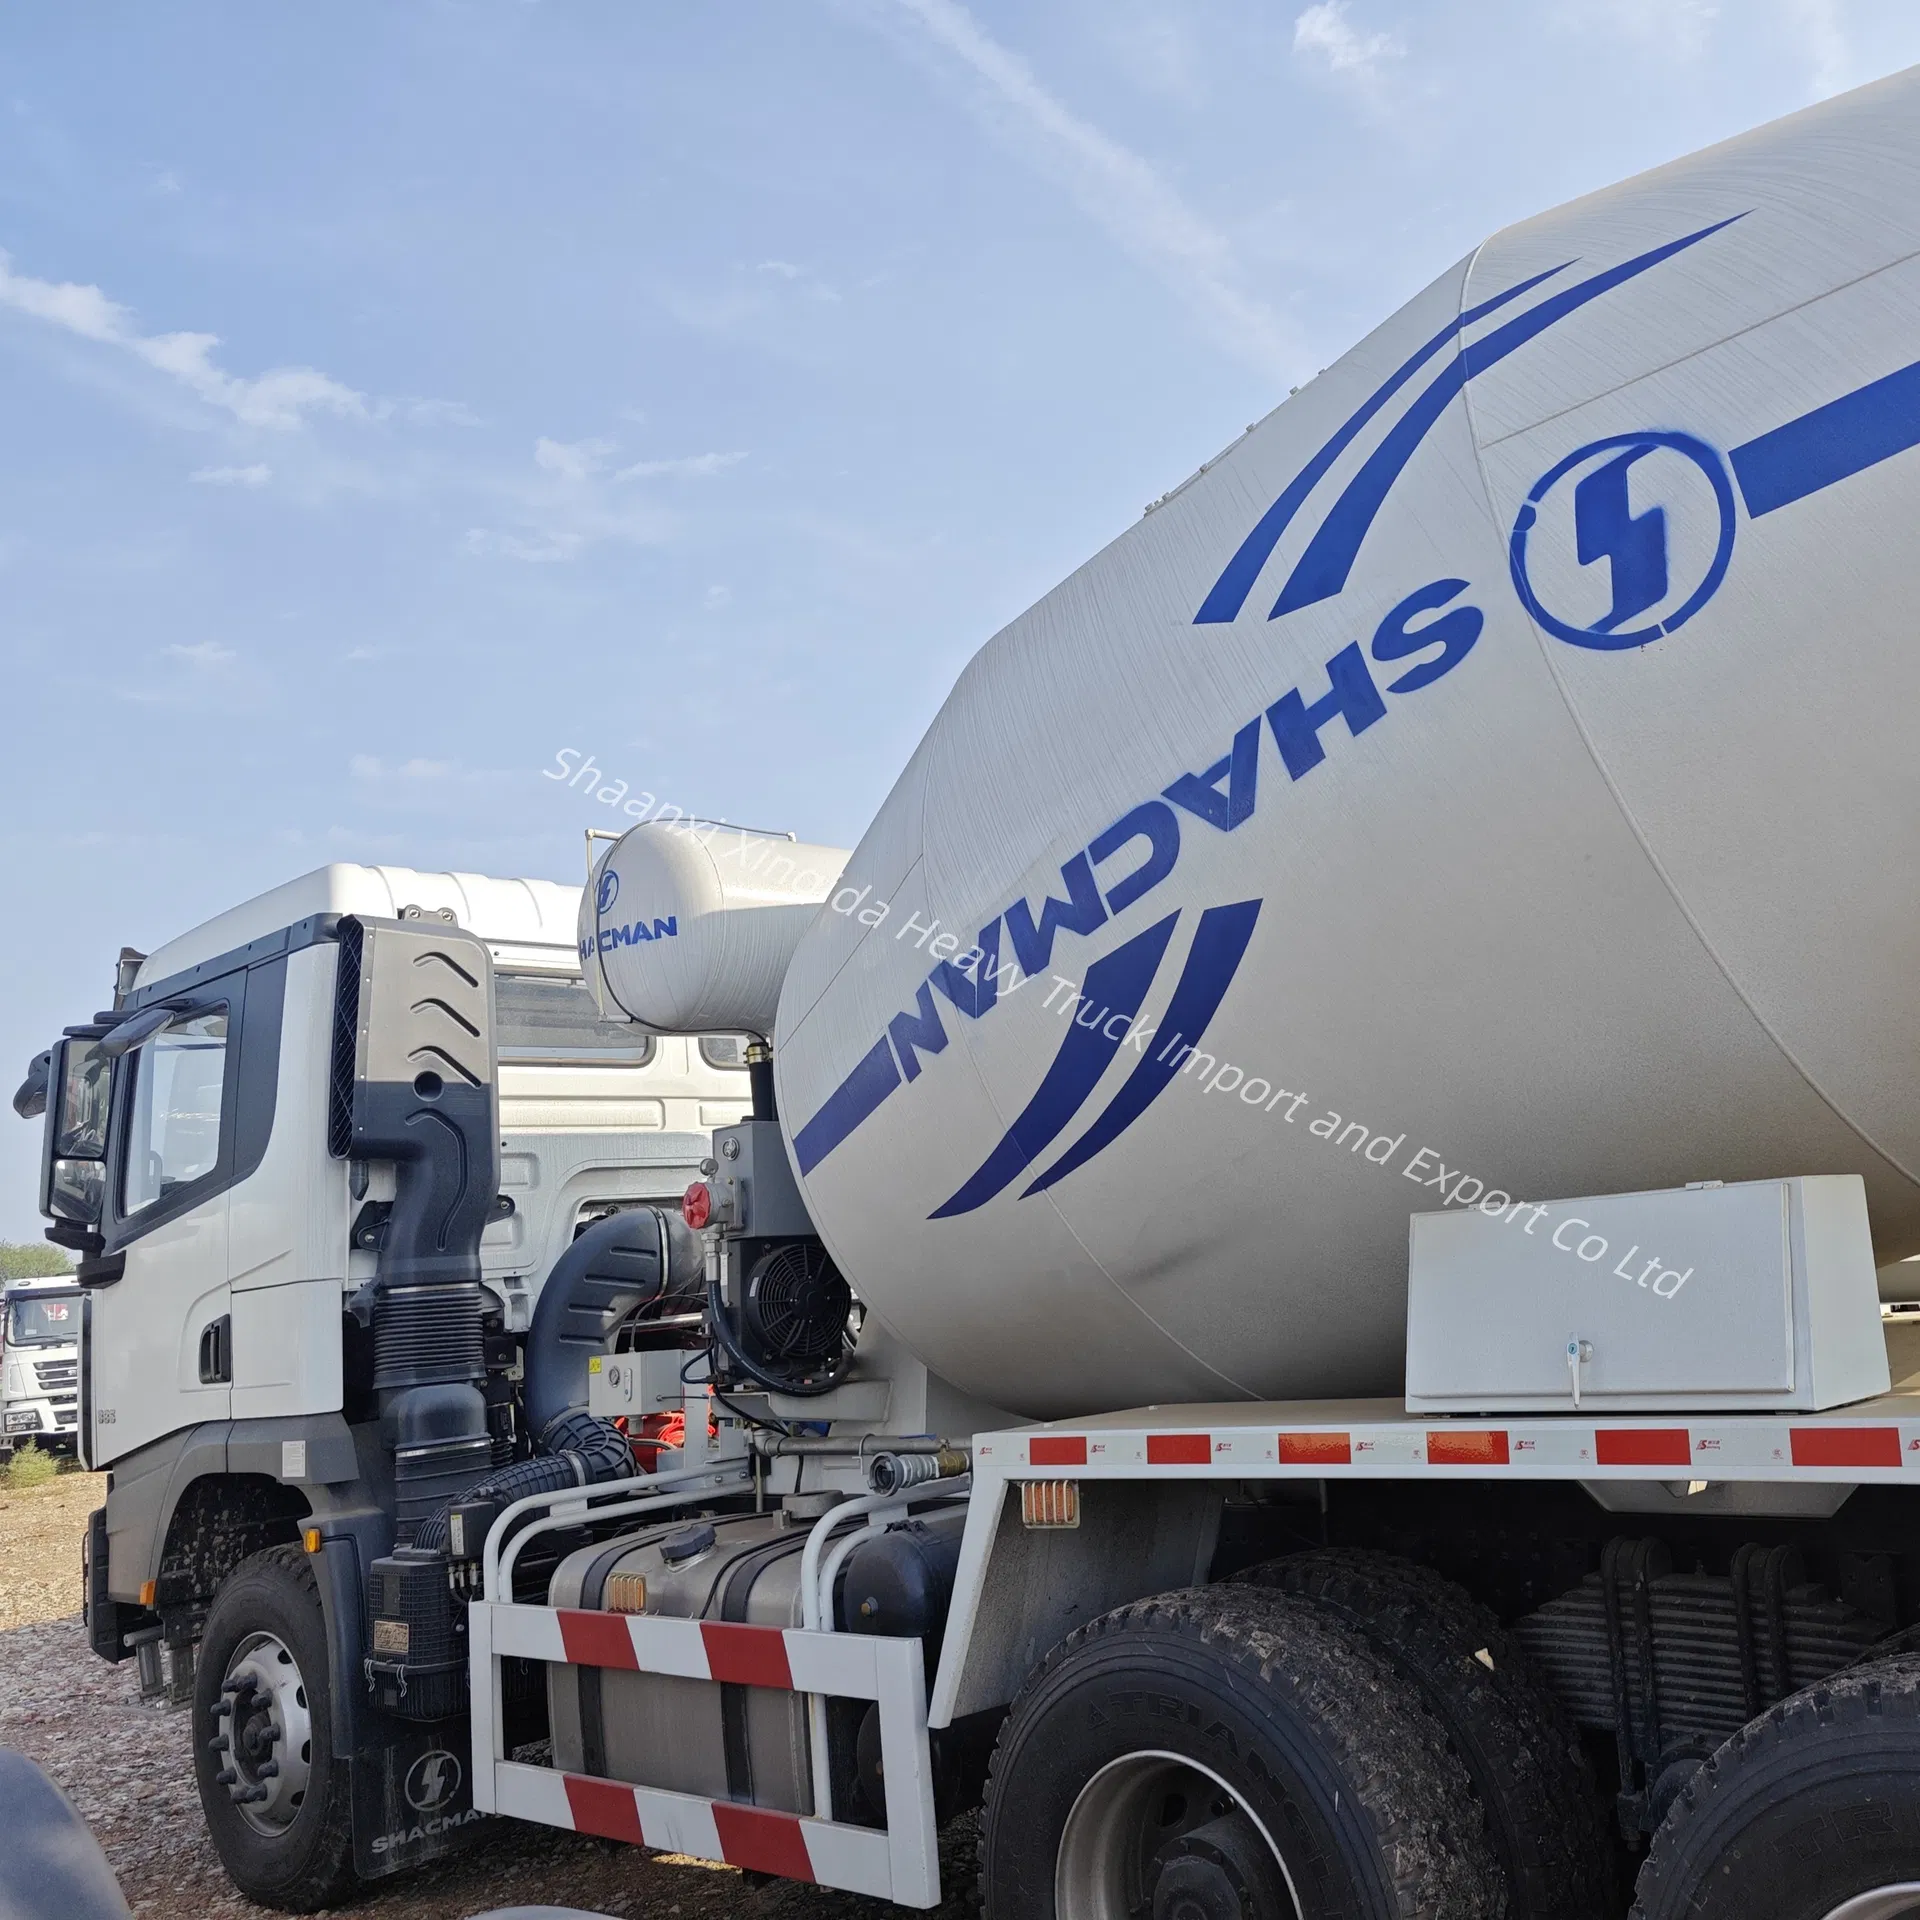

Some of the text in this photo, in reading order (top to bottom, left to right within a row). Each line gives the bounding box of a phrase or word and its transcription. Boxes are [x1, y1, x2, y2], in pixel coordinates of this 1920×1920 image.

[888, 579, 1485, 1084] SHACMAN
[578, 916, 678, 961] HACMAN
[371, 1808, 487, 1854] SHACMA
[1107, 1690, 1345, 1920] TRIANGL
